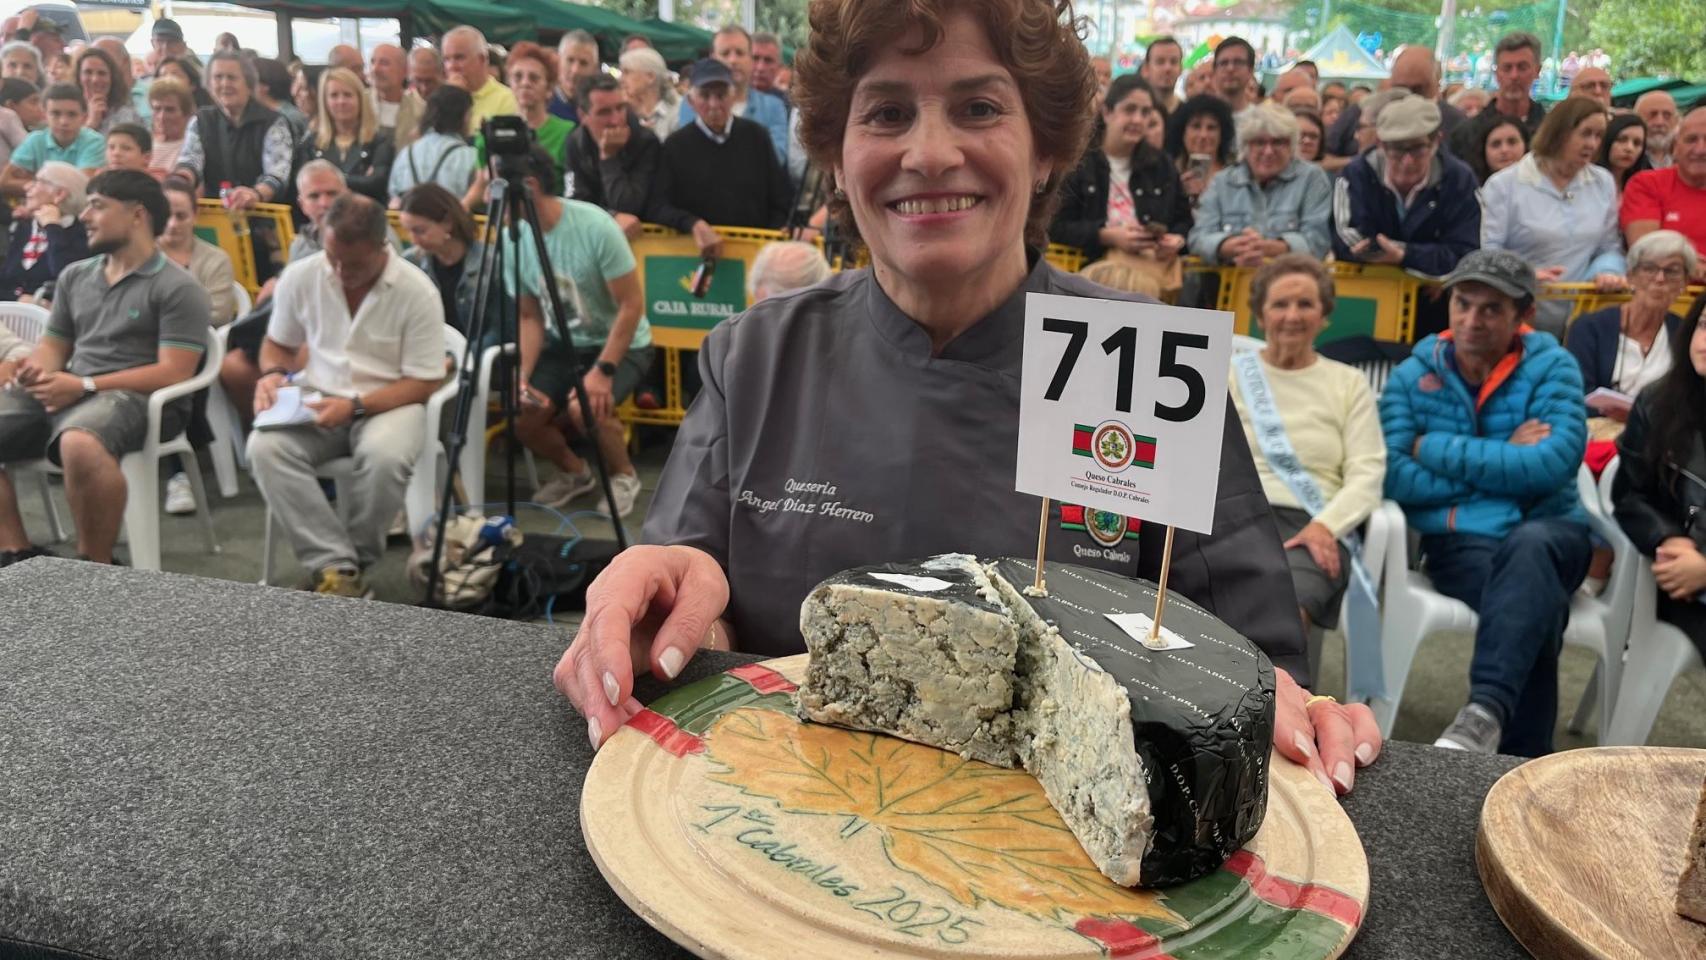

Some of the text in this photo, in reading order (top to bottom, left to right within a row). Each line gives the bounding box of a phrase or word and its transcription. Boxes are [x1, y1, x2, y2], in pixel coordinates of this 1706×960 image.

[653, 300, 689, 316] CAJA
[1042, 317, 1209, 422] 715
[1085, 470, 1137, 489] Queso Cabrales
[820, 501, 874, 523] Herrero
[1073, 544, 1101, 560] Queso
[1169, 763, 1191, 799] D.O.P.
[736, 828, 860, 897] Cabrales
[852, 885, 986, 944] 2025
